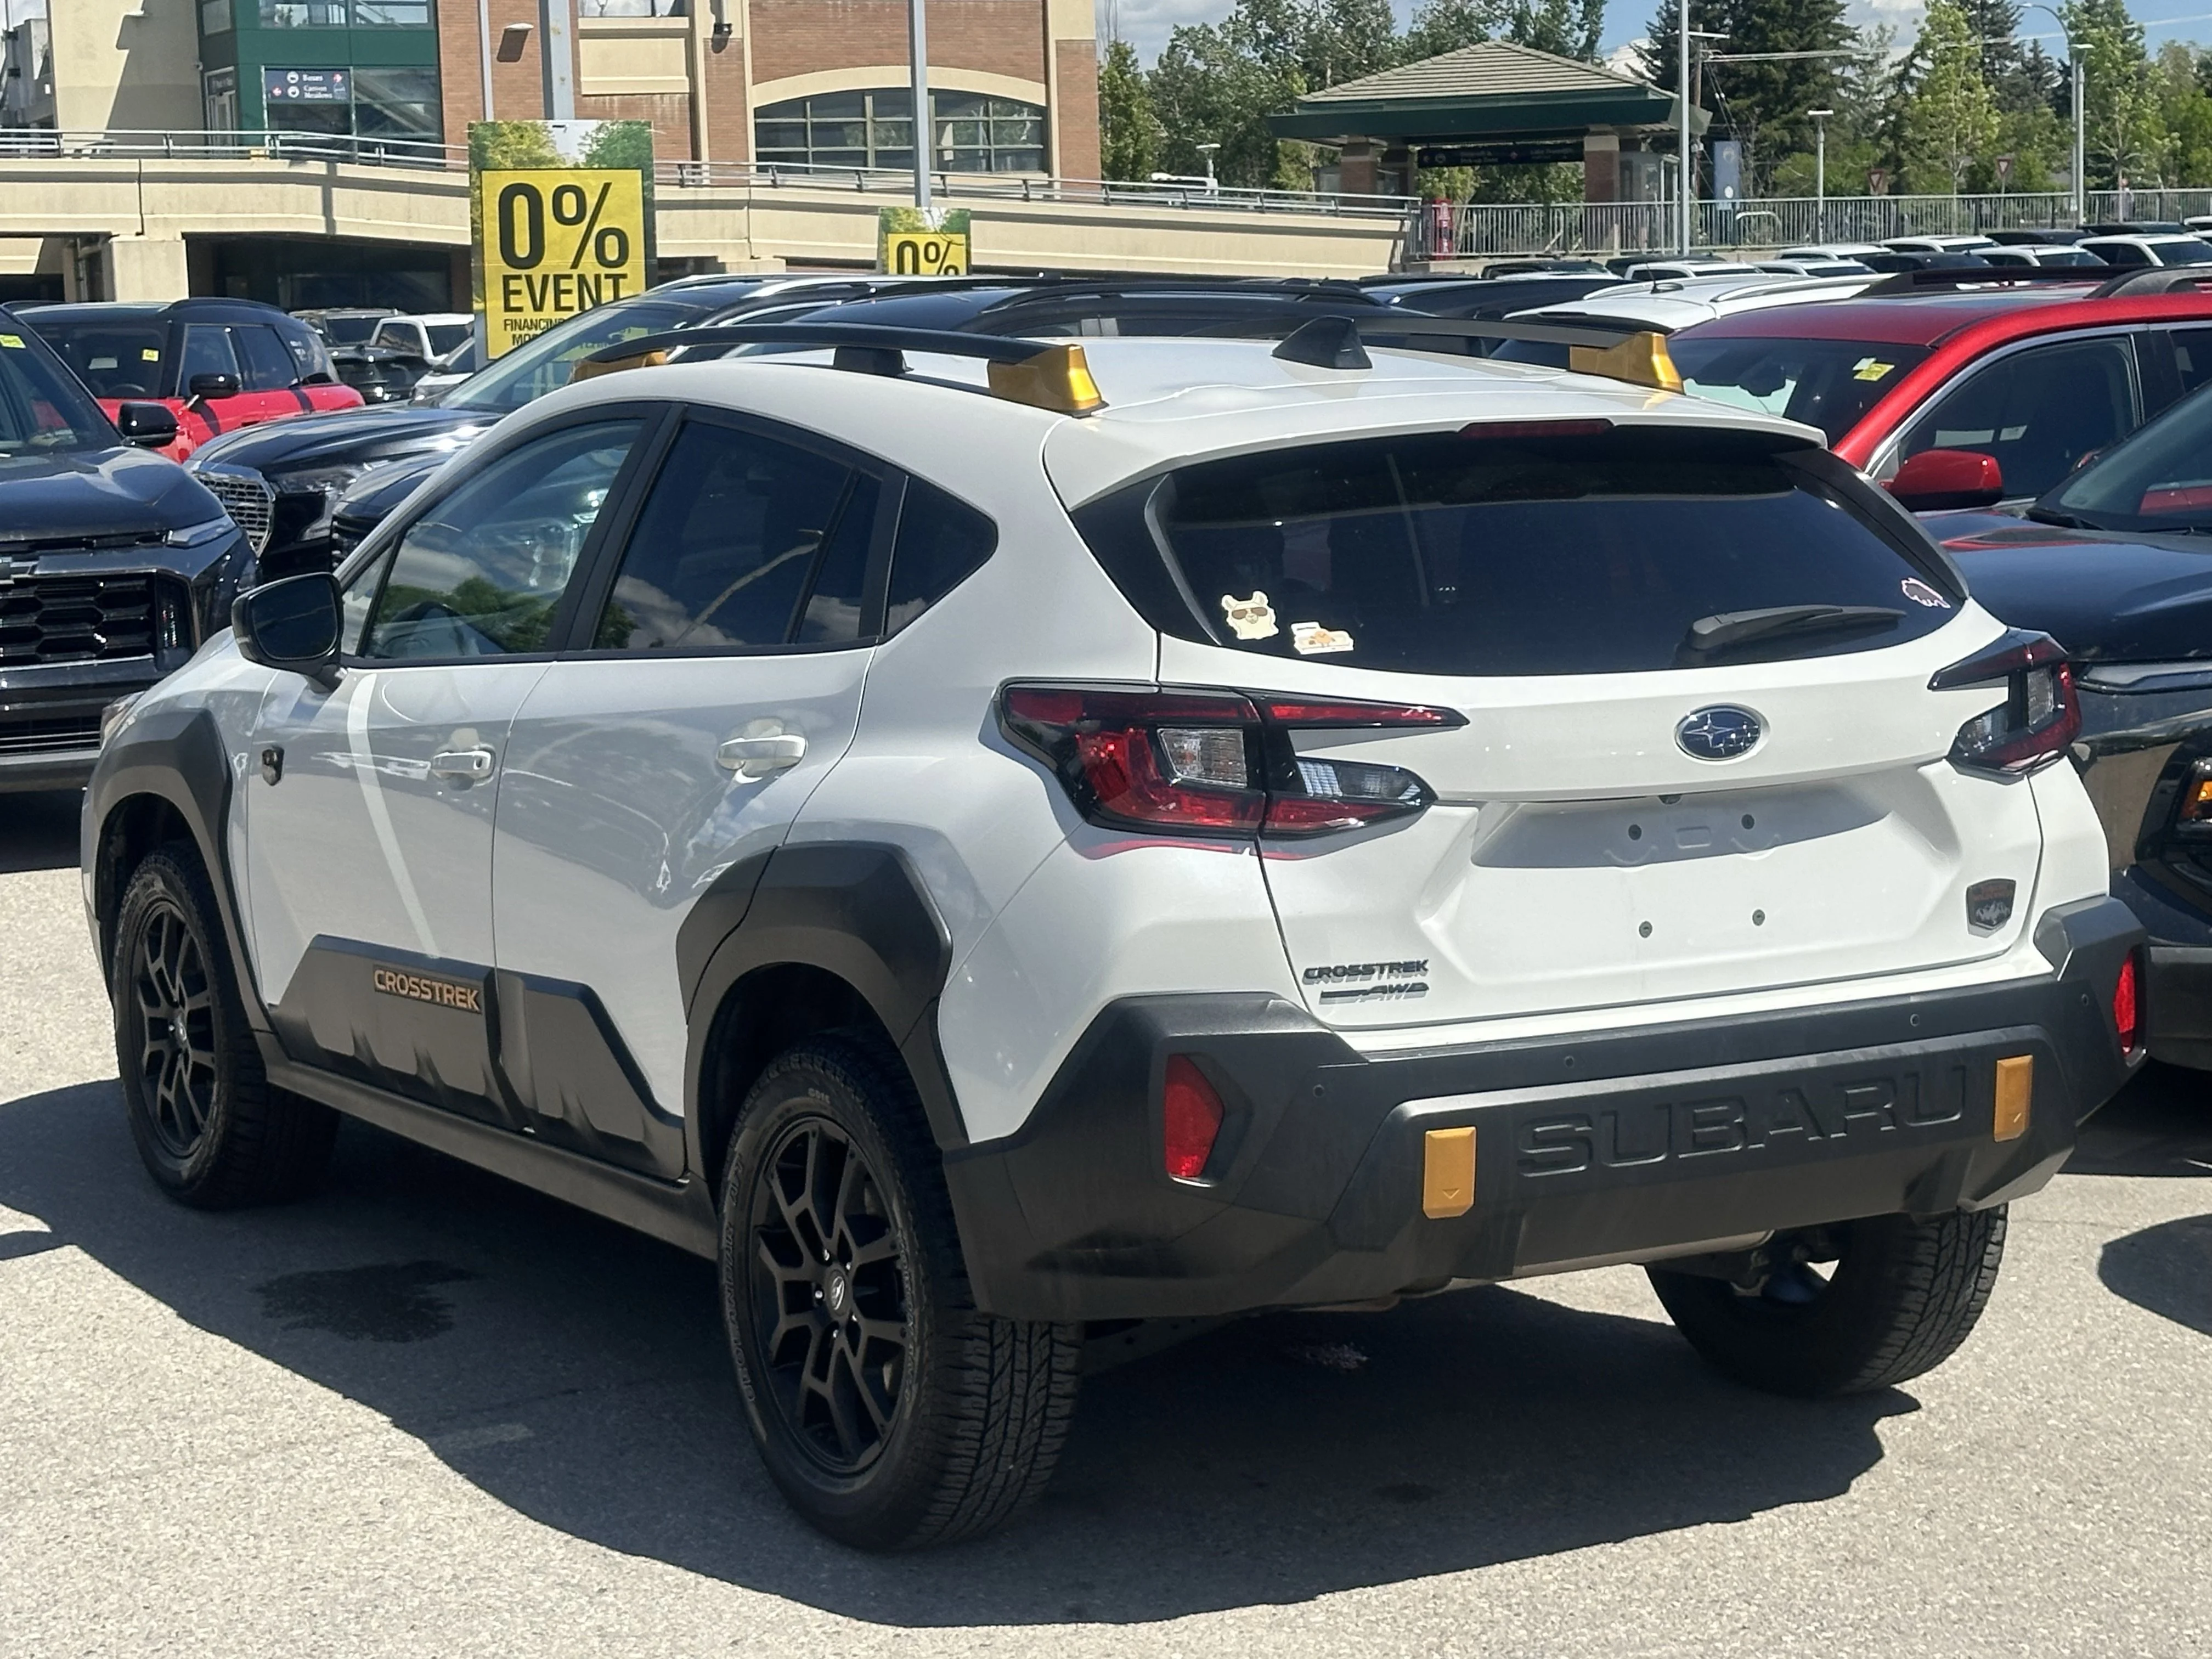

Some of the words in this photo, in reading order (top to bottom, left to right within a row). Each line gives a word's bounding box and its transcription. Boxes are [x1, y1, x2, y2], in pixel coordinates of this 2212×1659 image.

[498, 182, 630, 270] 0%
[896, 240, 960, 275] 0%
[503, 273, 628, 313] EVENT
[1303, 960, 1429, 980] CROSSTREK
[1367, 982, 1430, 997] AWD
[374, 969, 482, 1012] CROSSTREK
[1517, 1064, 1967, 1178] SUBARU
